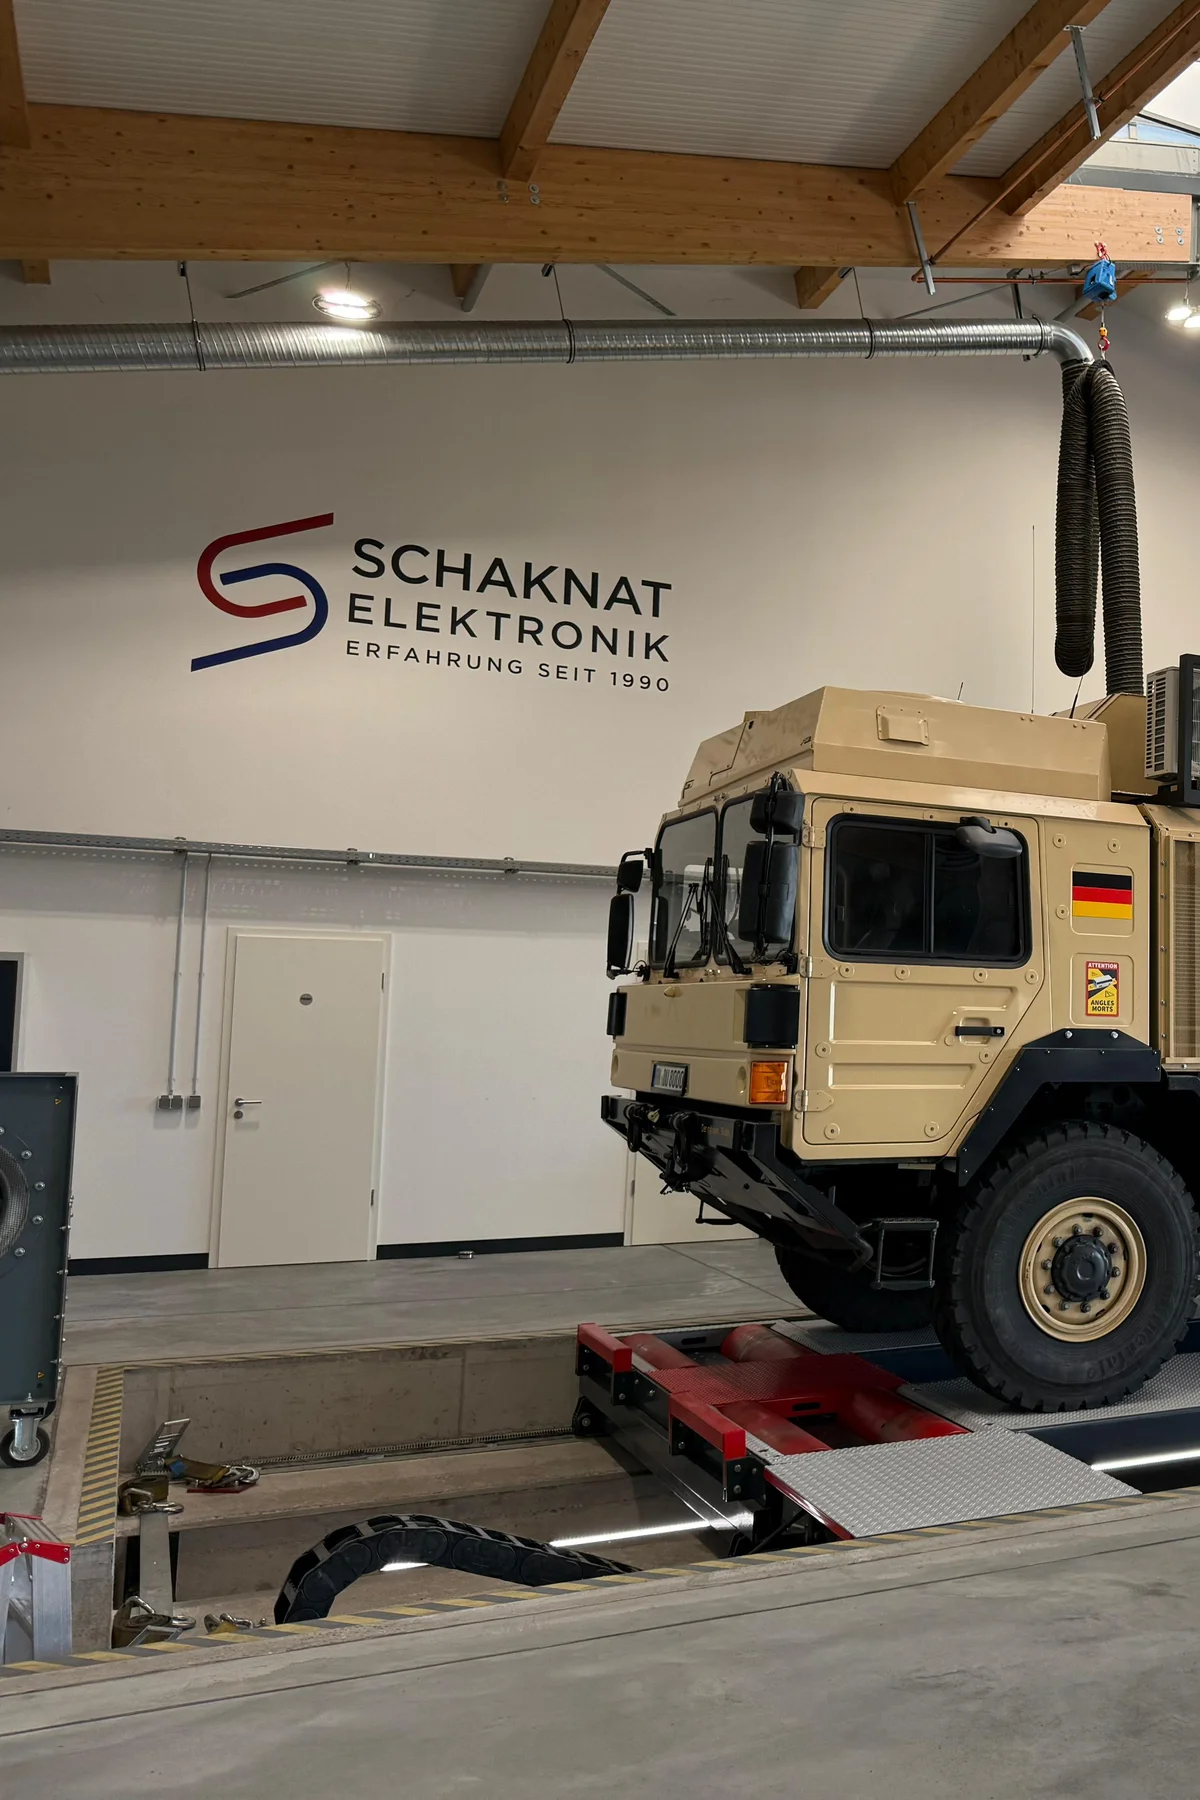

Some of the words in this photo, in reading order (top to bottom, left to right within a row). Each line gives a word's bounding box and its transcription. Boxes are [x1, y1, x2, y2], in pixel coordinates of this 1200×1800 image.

[351, 537, 672, 618] SCHAKNAT
[348, 592, 669, 662] ELEKTRONIK
[346, 640, 522, 675] ERFAHRUNG
[538, 663, 596, 683] SEIT
[610, 671, 669, 692] 1990
